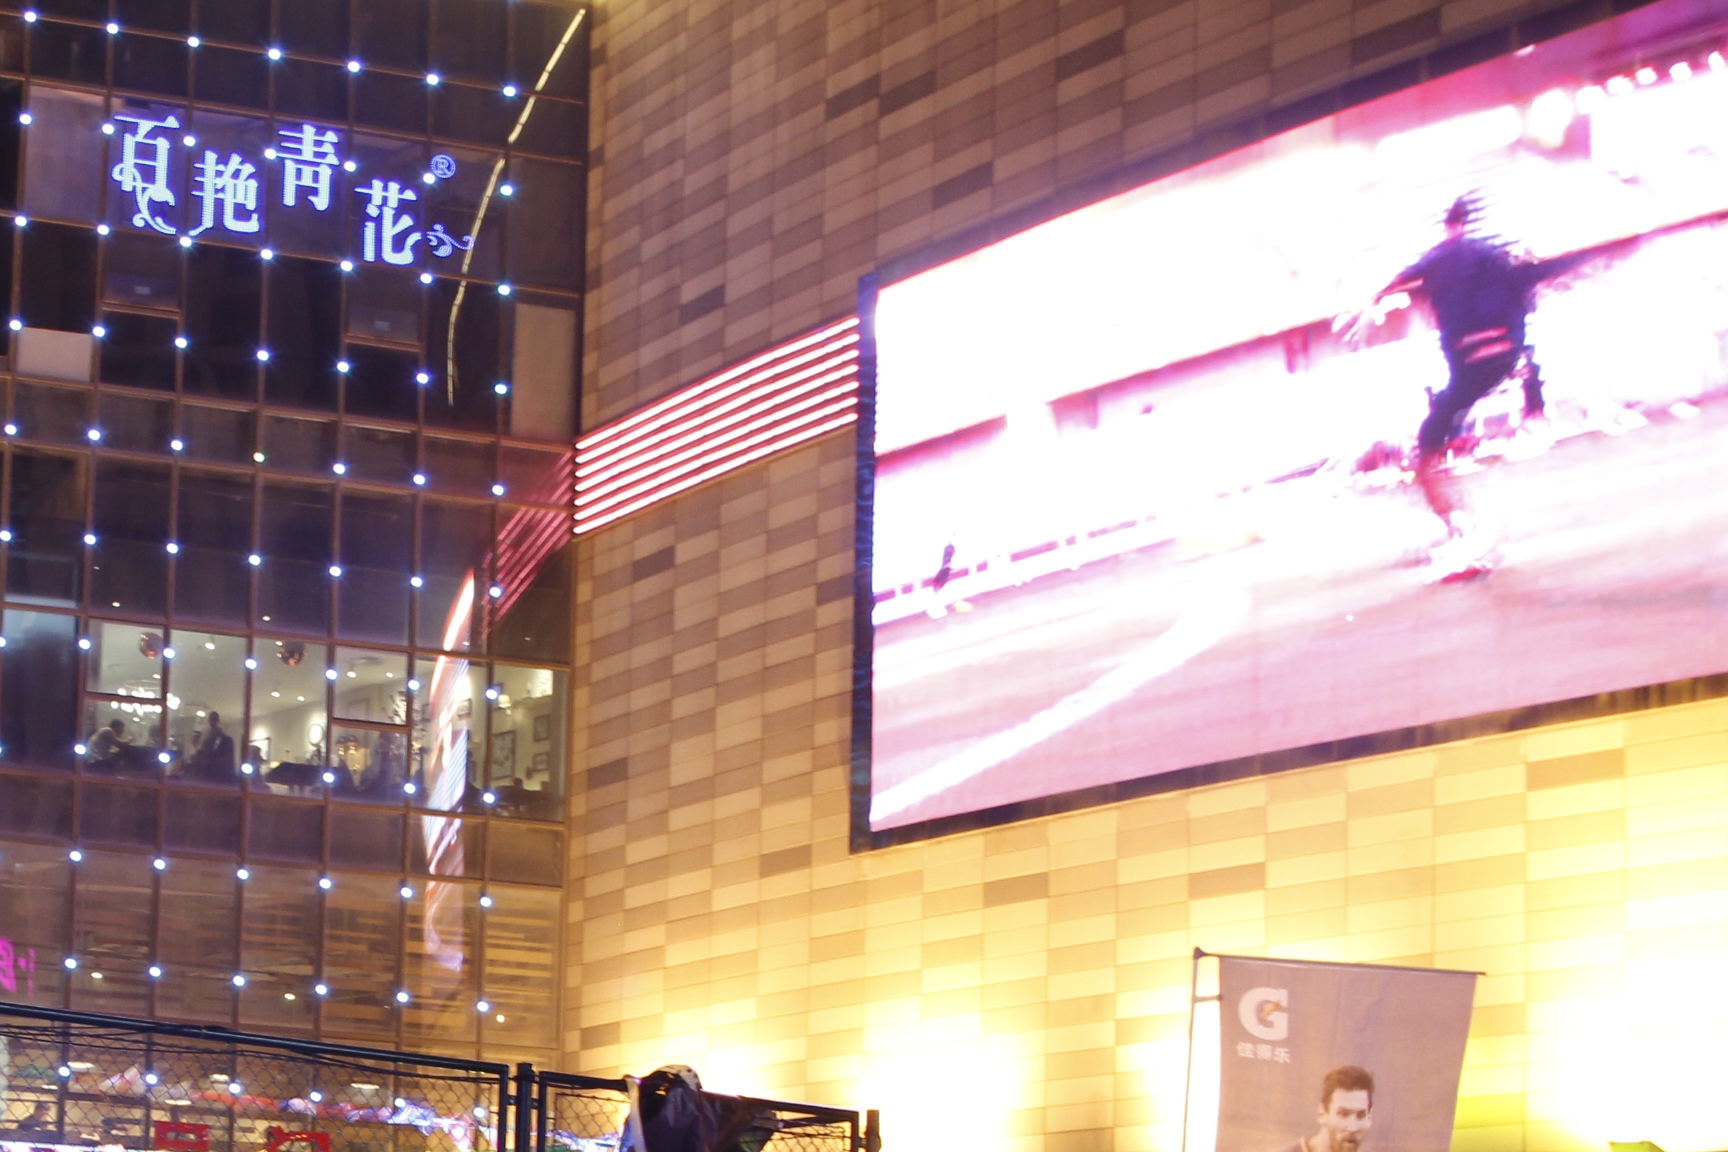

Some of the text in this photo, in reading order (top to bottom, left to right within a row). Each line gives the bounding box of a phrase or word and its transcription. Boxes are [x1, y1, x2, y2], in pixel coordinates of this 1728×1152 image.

[112, 115, 422, 265] 百艳青花
[1237, 986, 1289, 1041] G
